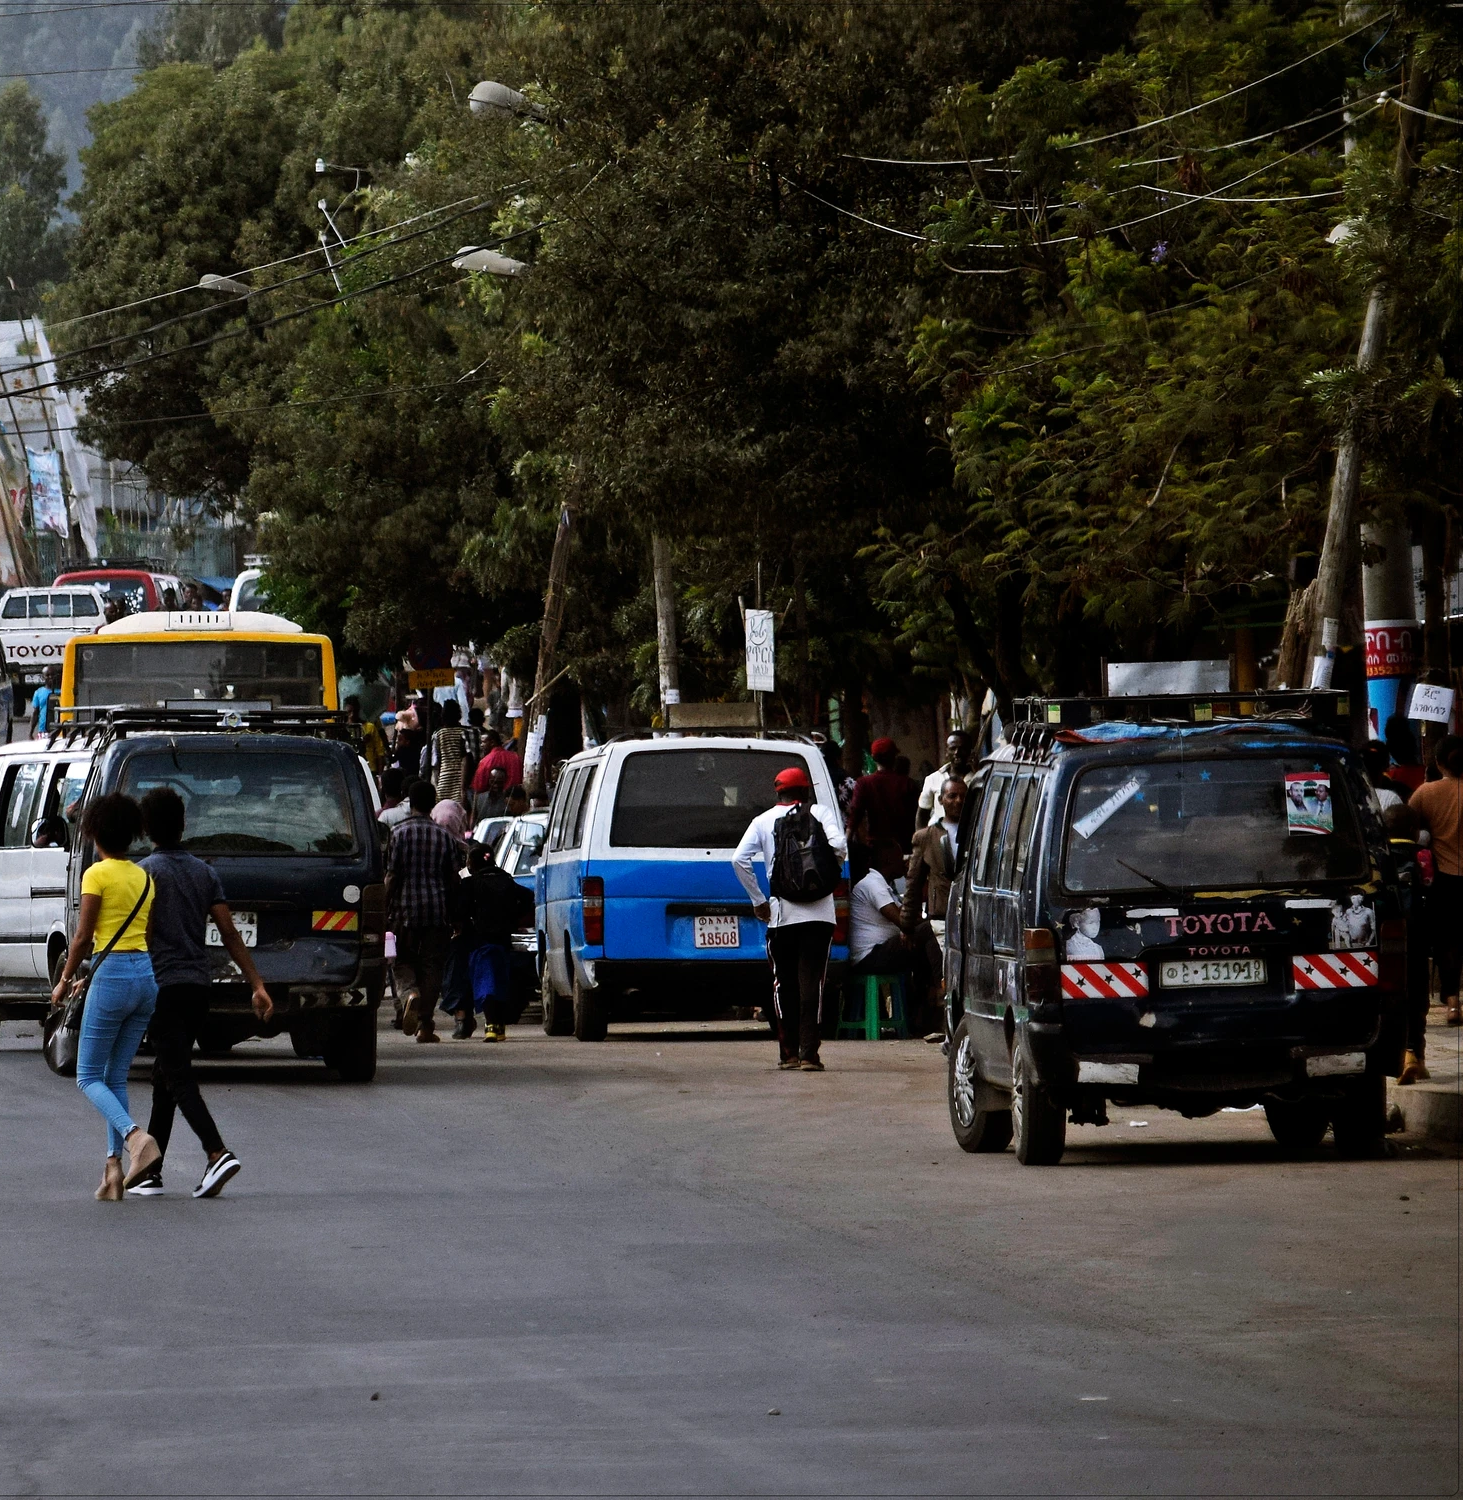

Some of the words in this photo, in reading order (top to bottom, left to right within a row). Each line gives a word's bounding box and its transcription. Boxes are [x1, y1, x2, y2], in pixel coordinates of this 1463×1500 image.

[6, 644, 66, 657] TOYOT
[1165, 911, 1276, 937] TOYOTA
[699, 932, 737, 946] 18508
[1188, 946, 1251, 956] TOYOTA
[1201, 961, 1252, 981] 13191
